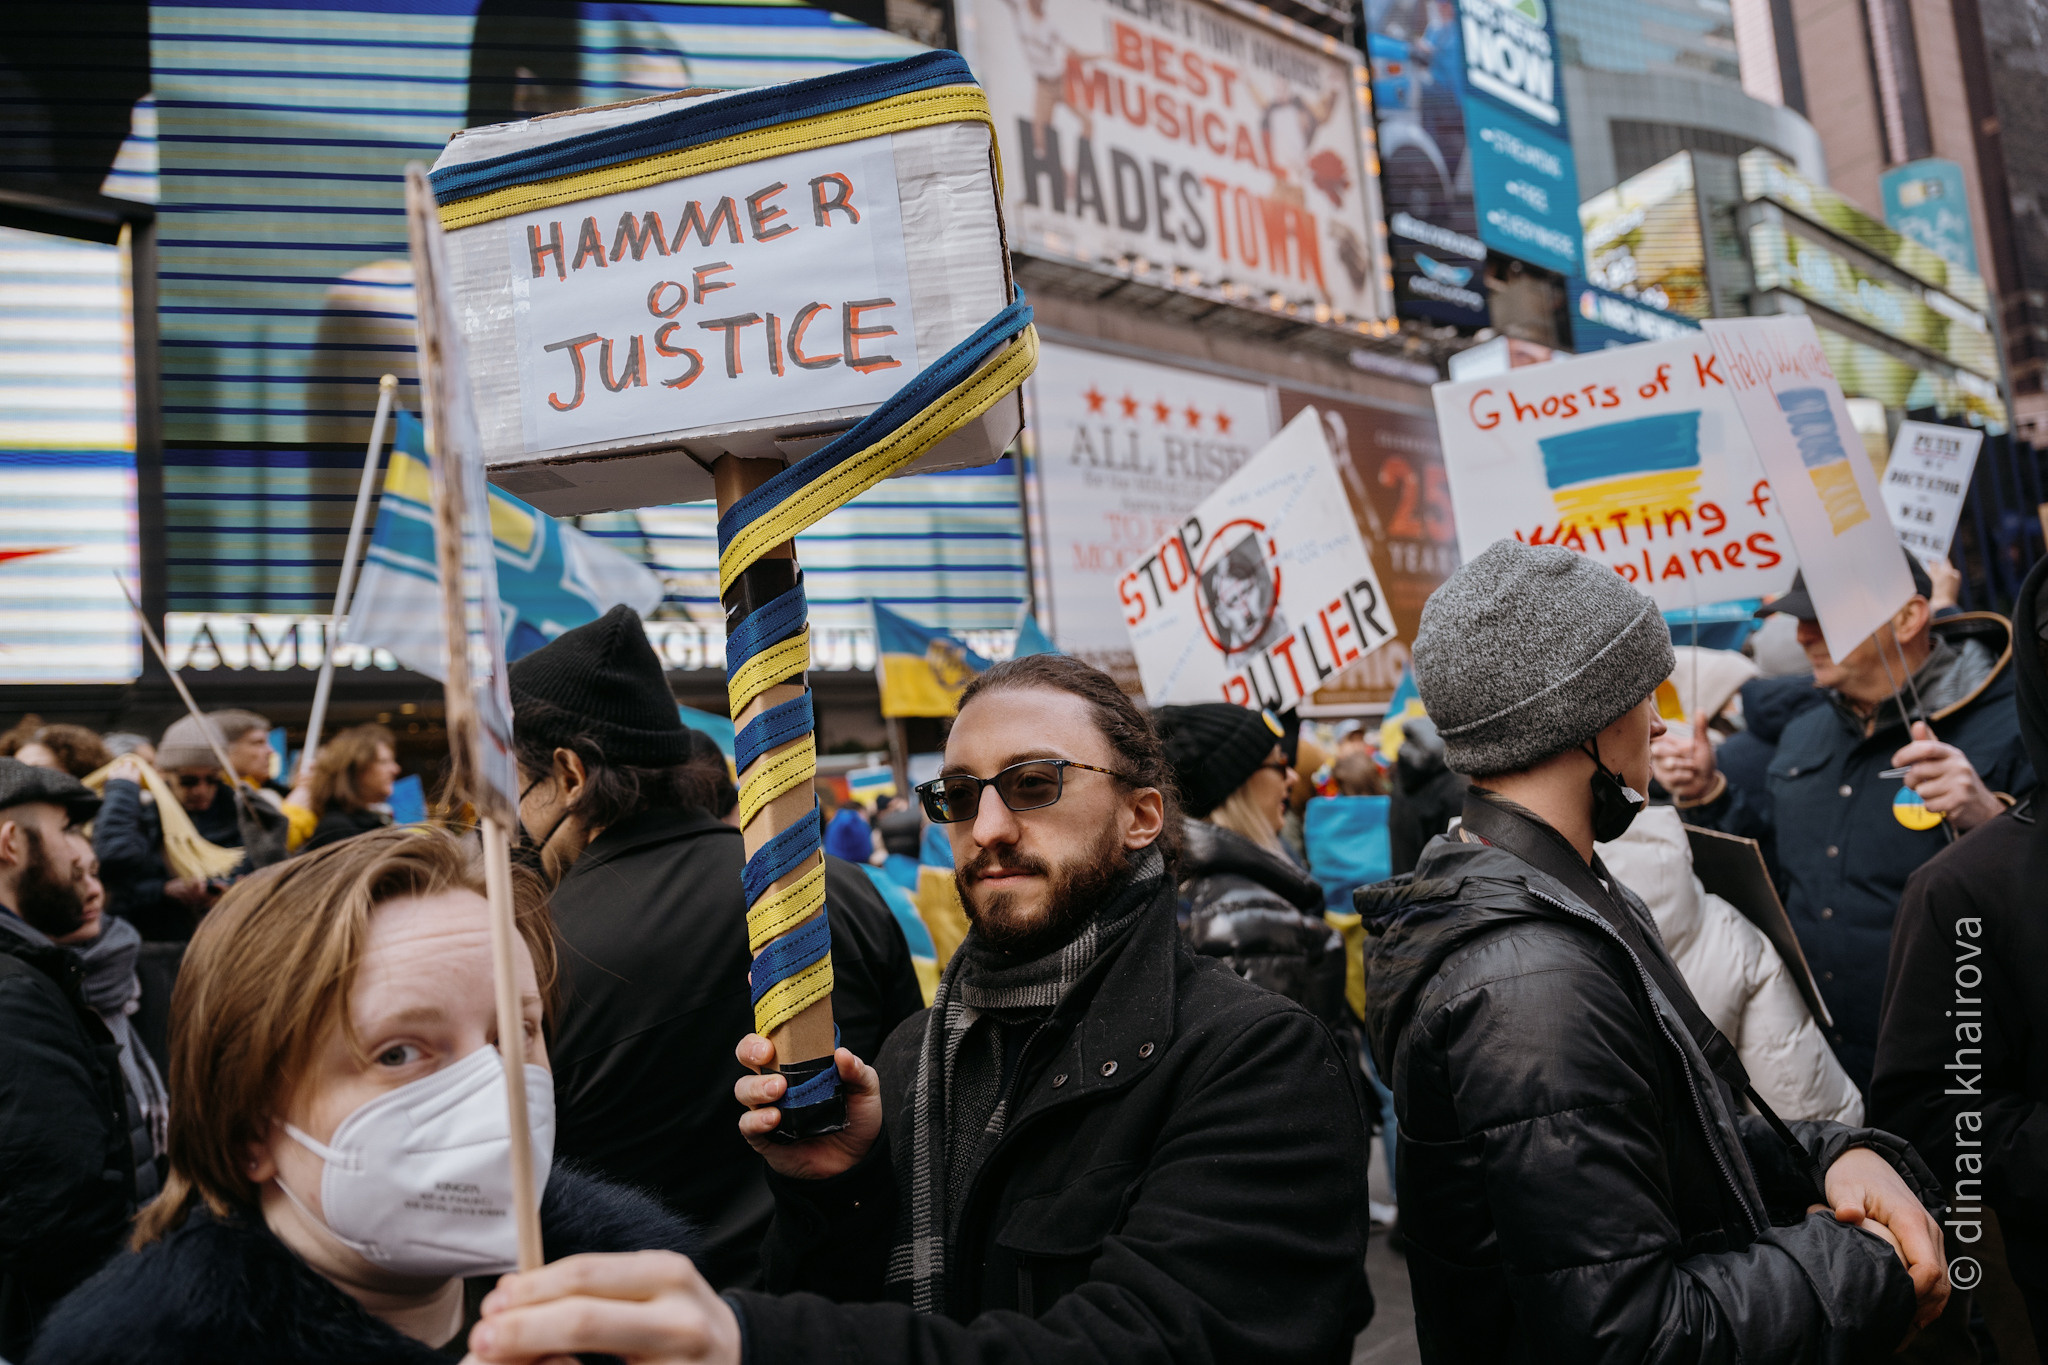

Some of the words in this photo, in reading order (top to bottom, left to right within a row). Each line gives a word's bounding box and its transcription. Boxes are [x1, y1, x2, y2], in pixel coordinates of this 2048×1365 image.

[1112, 20, 1240, 107] BEST
[1065, 60, 1288, 180] MUSICAL
[527, 172, 861, 281] HAMMER
[648, 261, 736, 319] OF
[544, 297, 902, 412] JUSTICE
[1639, 364, 1672, 399] of
[1694, 353, 1725, 388] K
[1712, 331, 1782, 413] Help
[1069, 424, 1153, 474] ALL
[1378, 457, 1456, 541] 25
[1119, 517, 1203, 626] STOP
[1221, 579, 1388, 714] PUTLER
